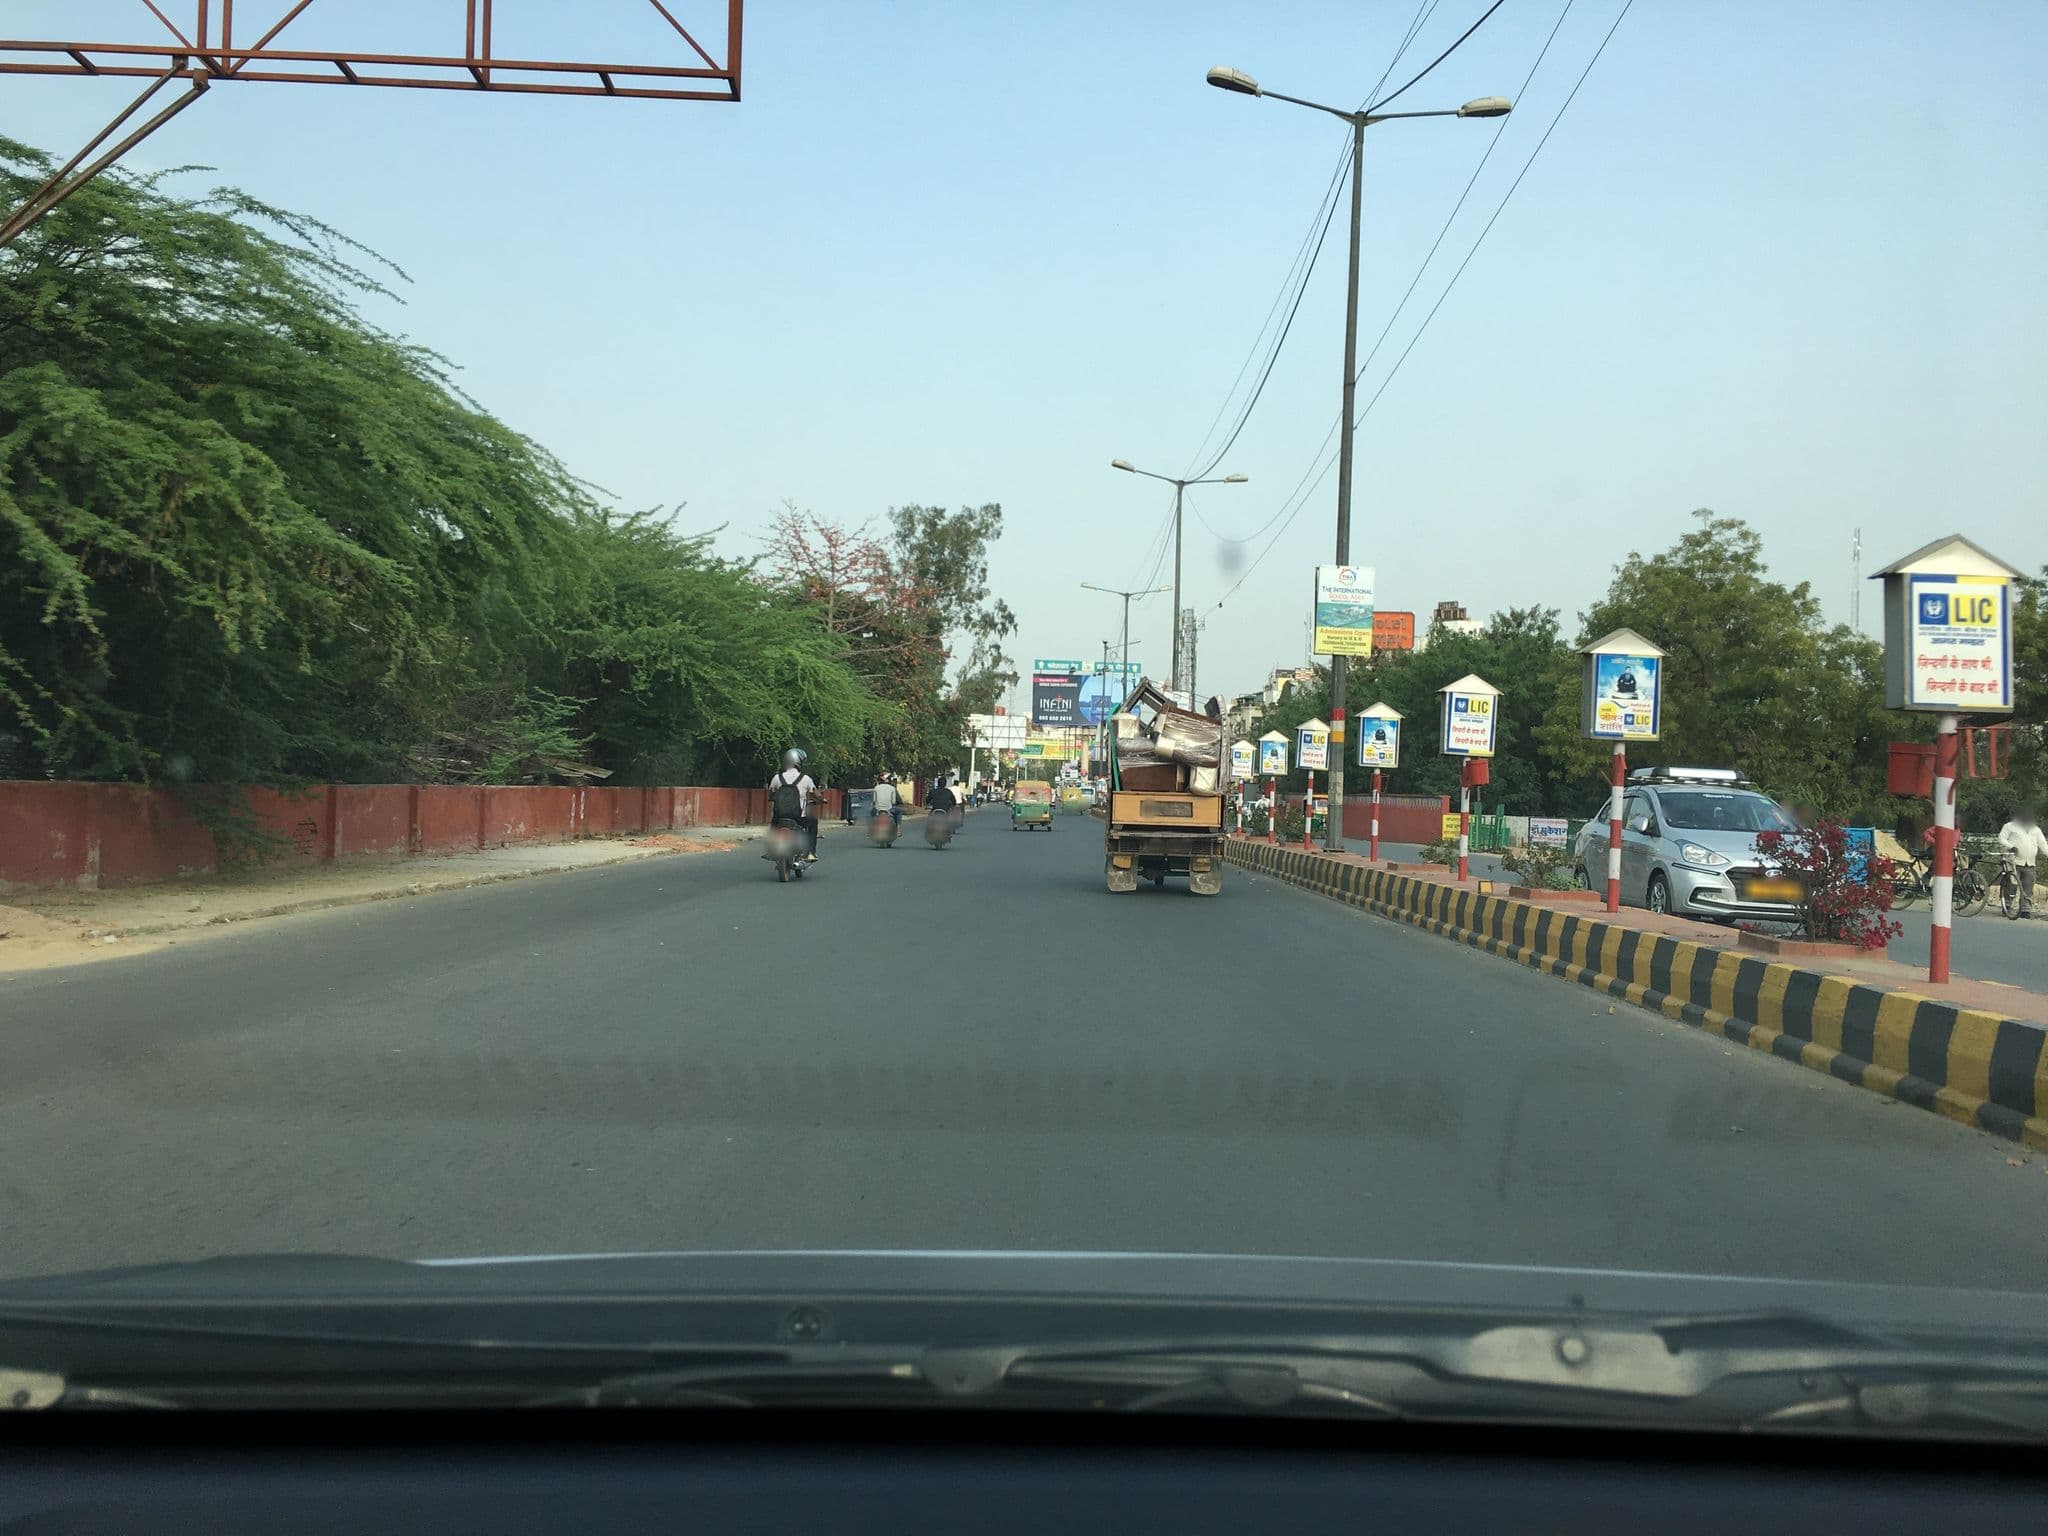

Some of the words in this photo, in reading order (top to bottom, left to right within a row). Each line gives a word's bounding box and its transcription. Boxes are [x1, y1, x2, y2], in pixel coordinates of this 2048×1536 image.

[1954, 597, 1992, 623] LIC
[1320, 628, 1353, 636] Admissions
[1470, 700, 1489, 714] LIC
[1636, 715, 1650, 725] LIC
[1313, 736, 1325, 744] LIC
